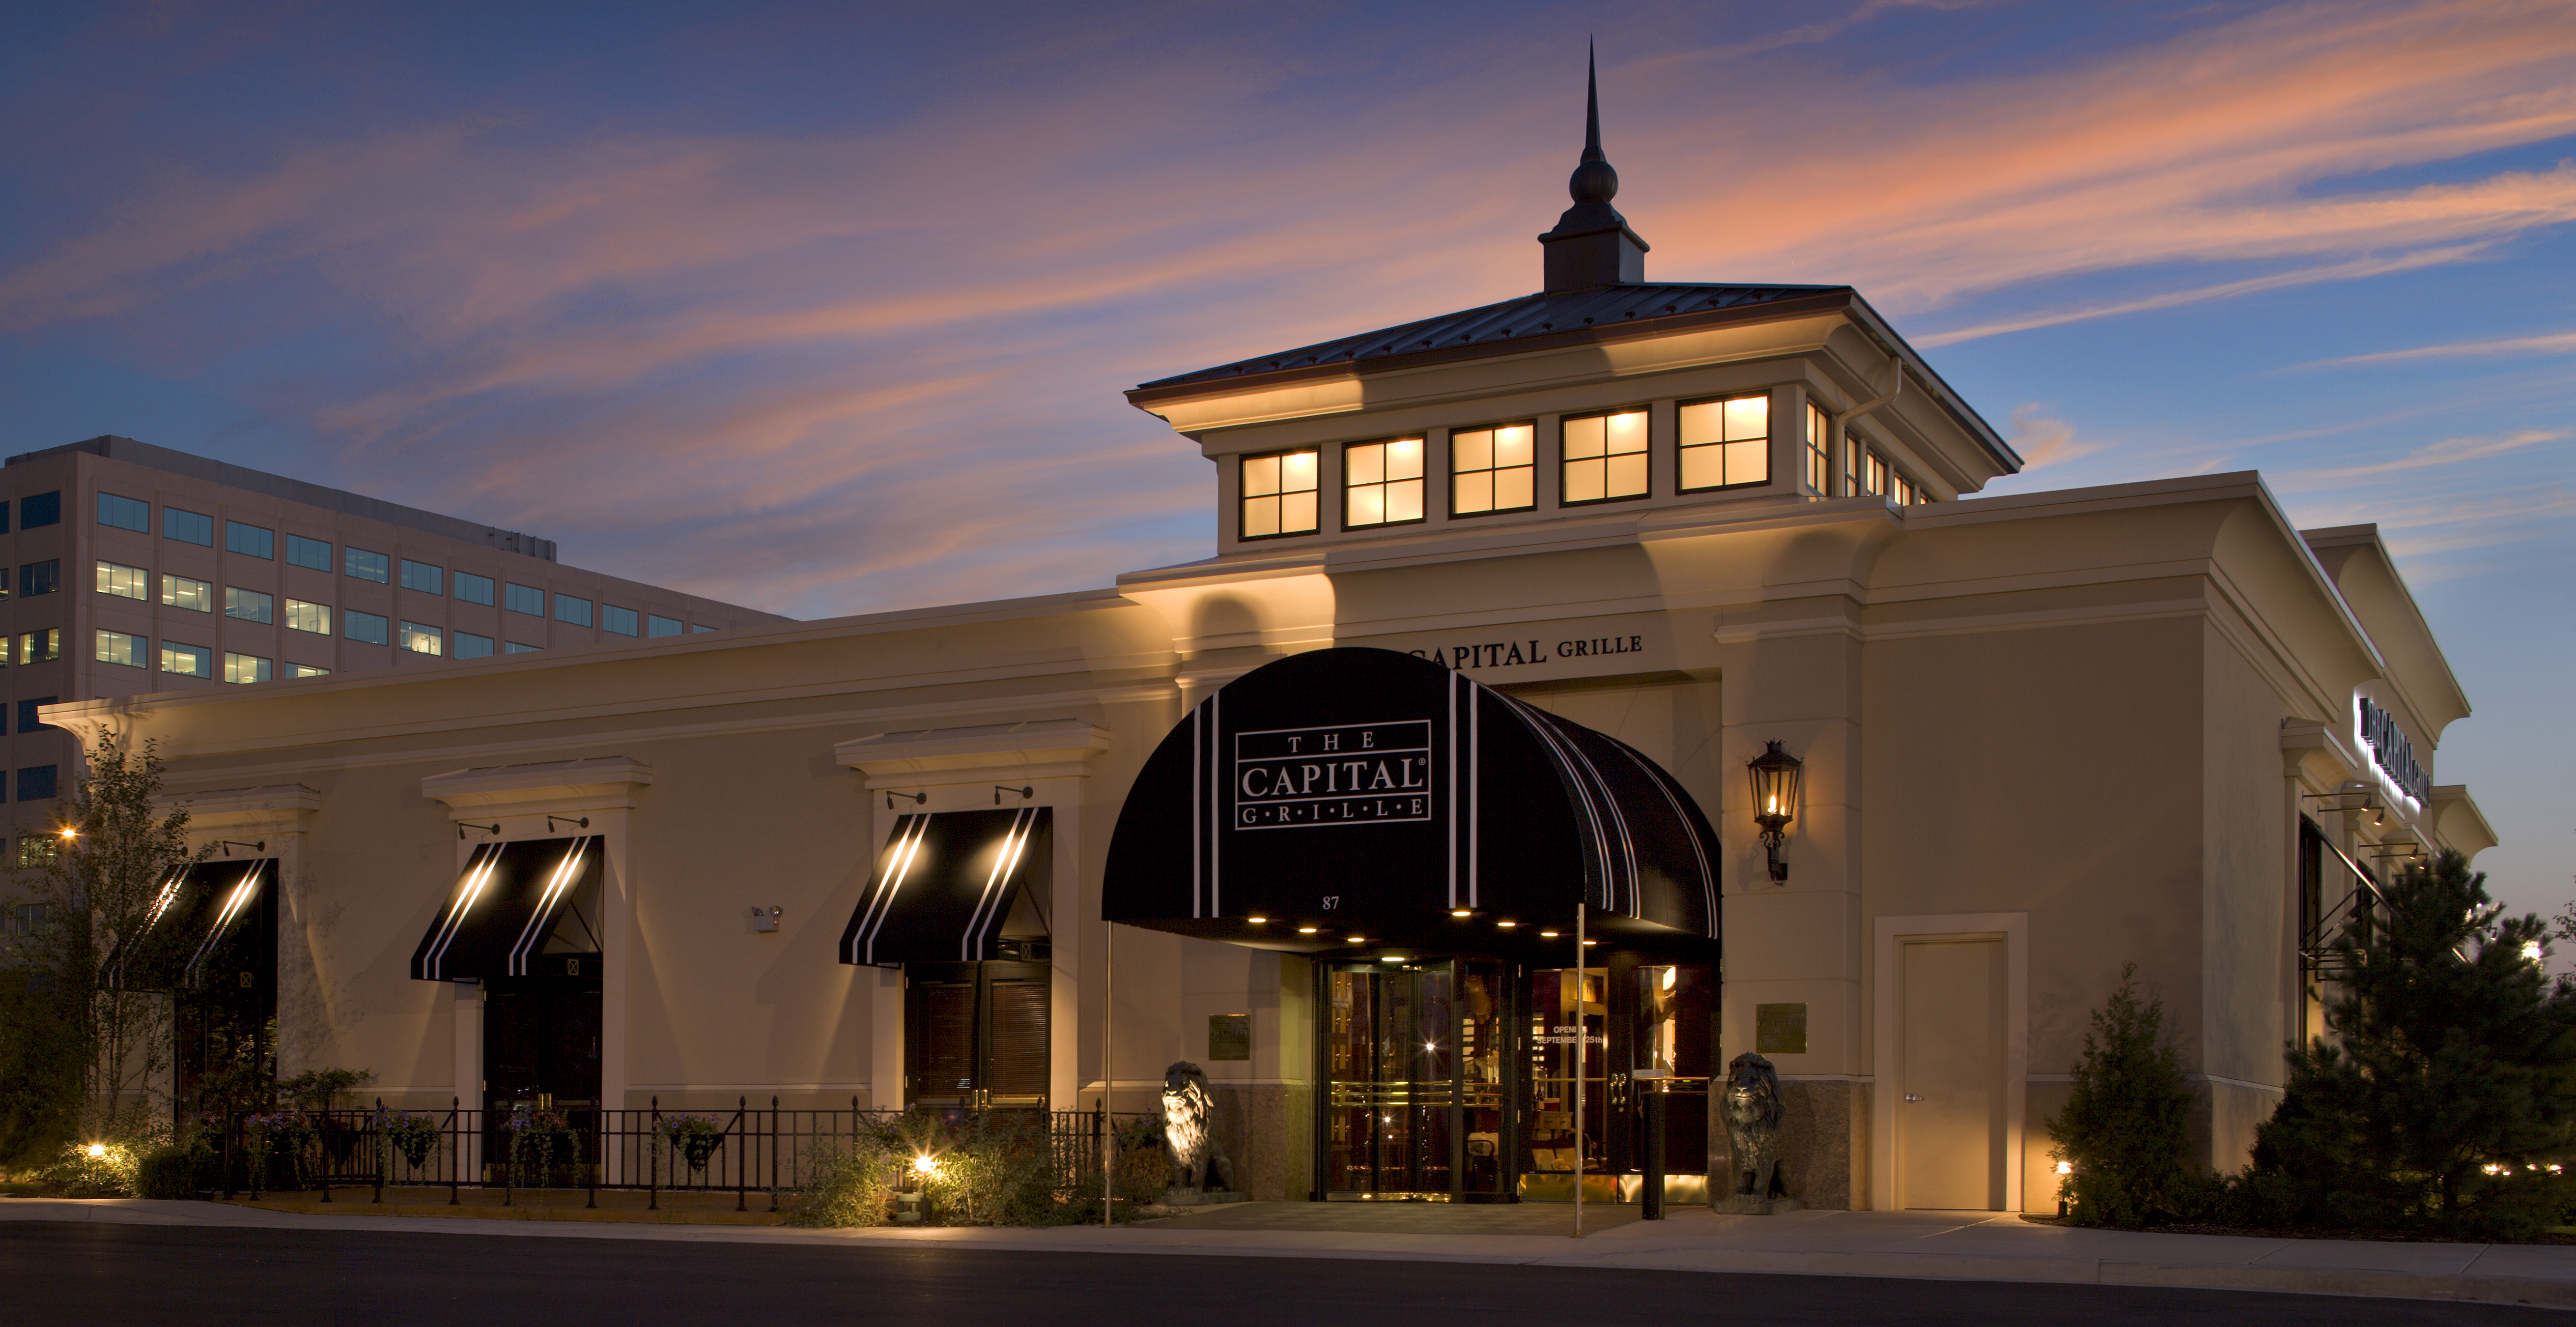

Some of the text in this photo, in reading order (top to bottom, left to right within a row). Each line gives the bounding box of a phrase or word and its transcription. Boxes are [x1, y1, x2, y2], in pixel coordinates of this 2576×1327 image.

[1557, 636, 1642, 658] GRILLE
[1288, 731, 1374, 753] THE
[1323, 896, 1339, 910] 87
